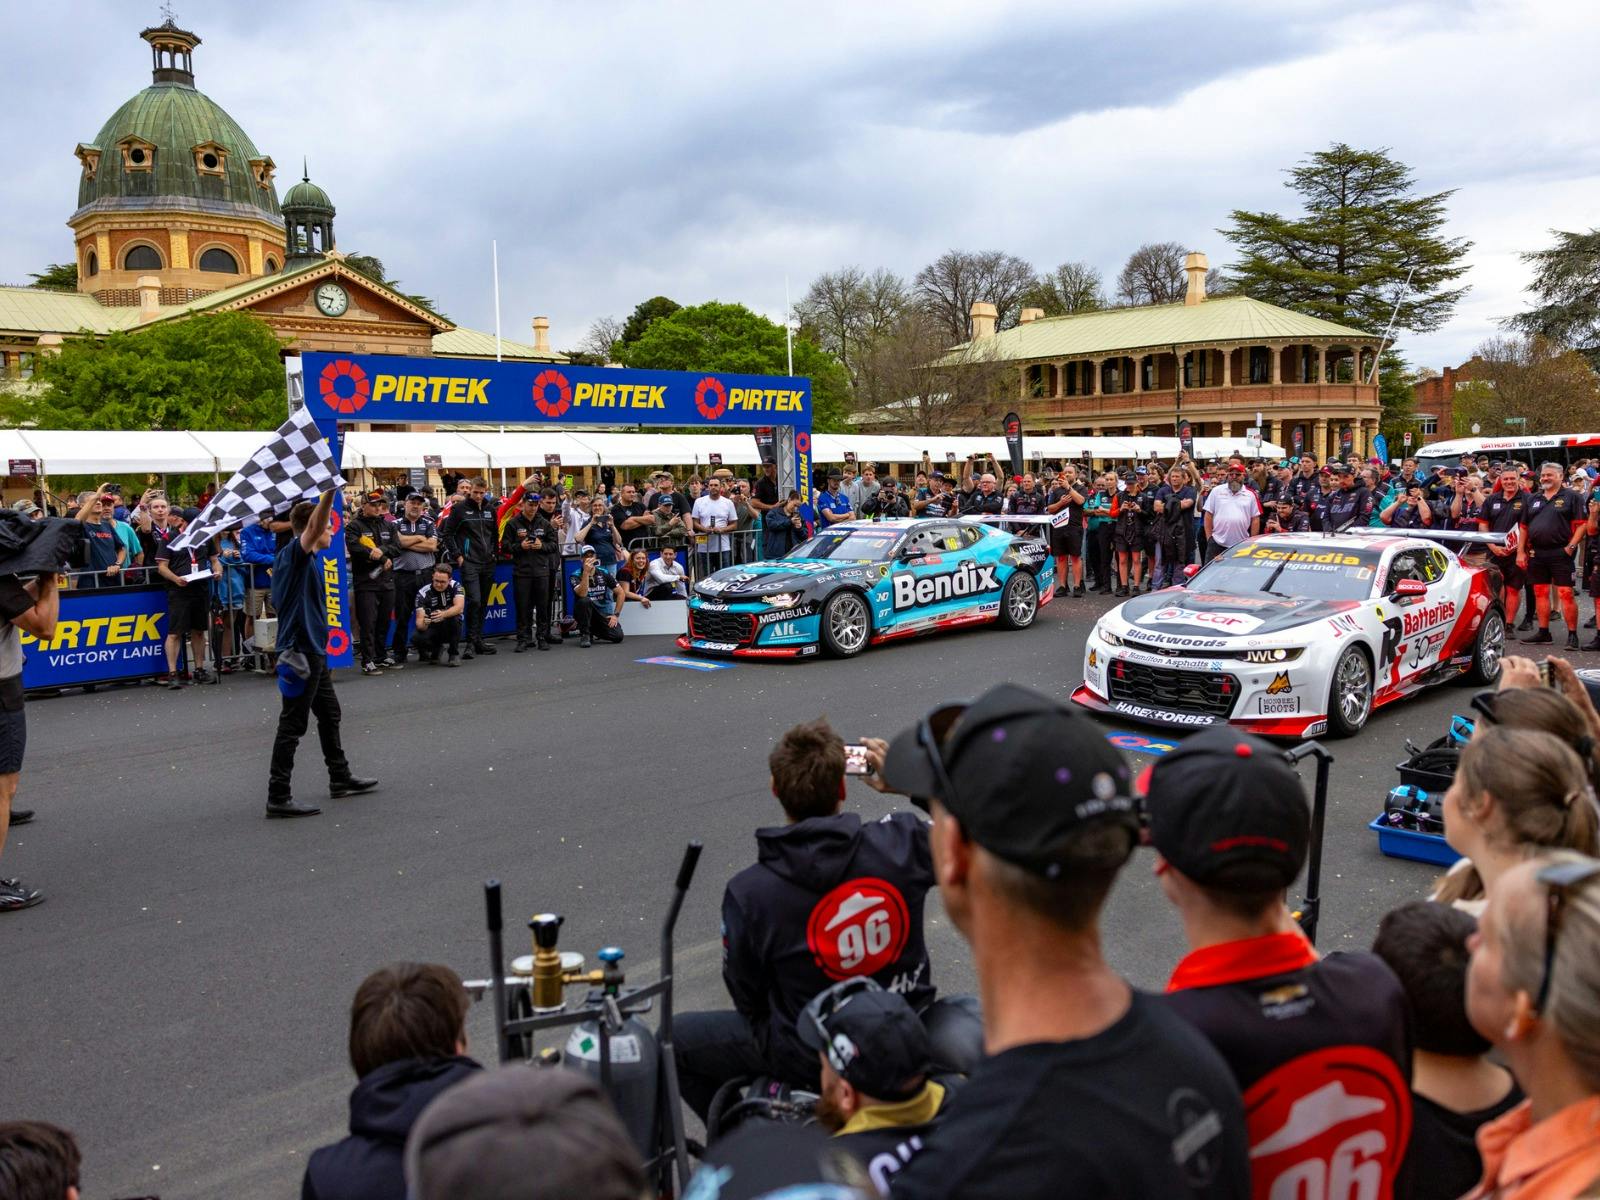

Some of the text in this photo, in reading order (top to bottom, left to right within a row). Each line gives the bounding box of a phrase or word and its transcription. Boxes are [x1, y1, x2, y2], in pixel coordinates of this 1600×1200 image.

[372, 375, 491, 404] PIRTEK
[573, 383, 667, 409] PIRTEK
[727, 388, 805, 412] PIRTEK
[798, 452, 809, 507] PIRTEK
[1019, 543, 1045, 555] ASTRAL
[323, 556, 342, 628] PIRTEK
[893, 562, 999, 609] Bendix
[485, 608, 507, 620] ANE
[700, 601, 729, 611] Bendix
[759, 605, 812, 624] MGMBULK
[979, 603, 999, 611] DAF
[1403, 601, 1456, 636] Batteries
[771, 622, 800, 637] Alt.
[1126, 629, 1228, 647] Blackwoods
[49, 644, 162, 667] VICTORY LANE
[1128, 651, 1209, 668] Hamilton Asphalts
[1242, 650, 1276, 662] JWL
[1263, 704, 1295, 714] BOOTS
[837, 908, 892, 970] 96
